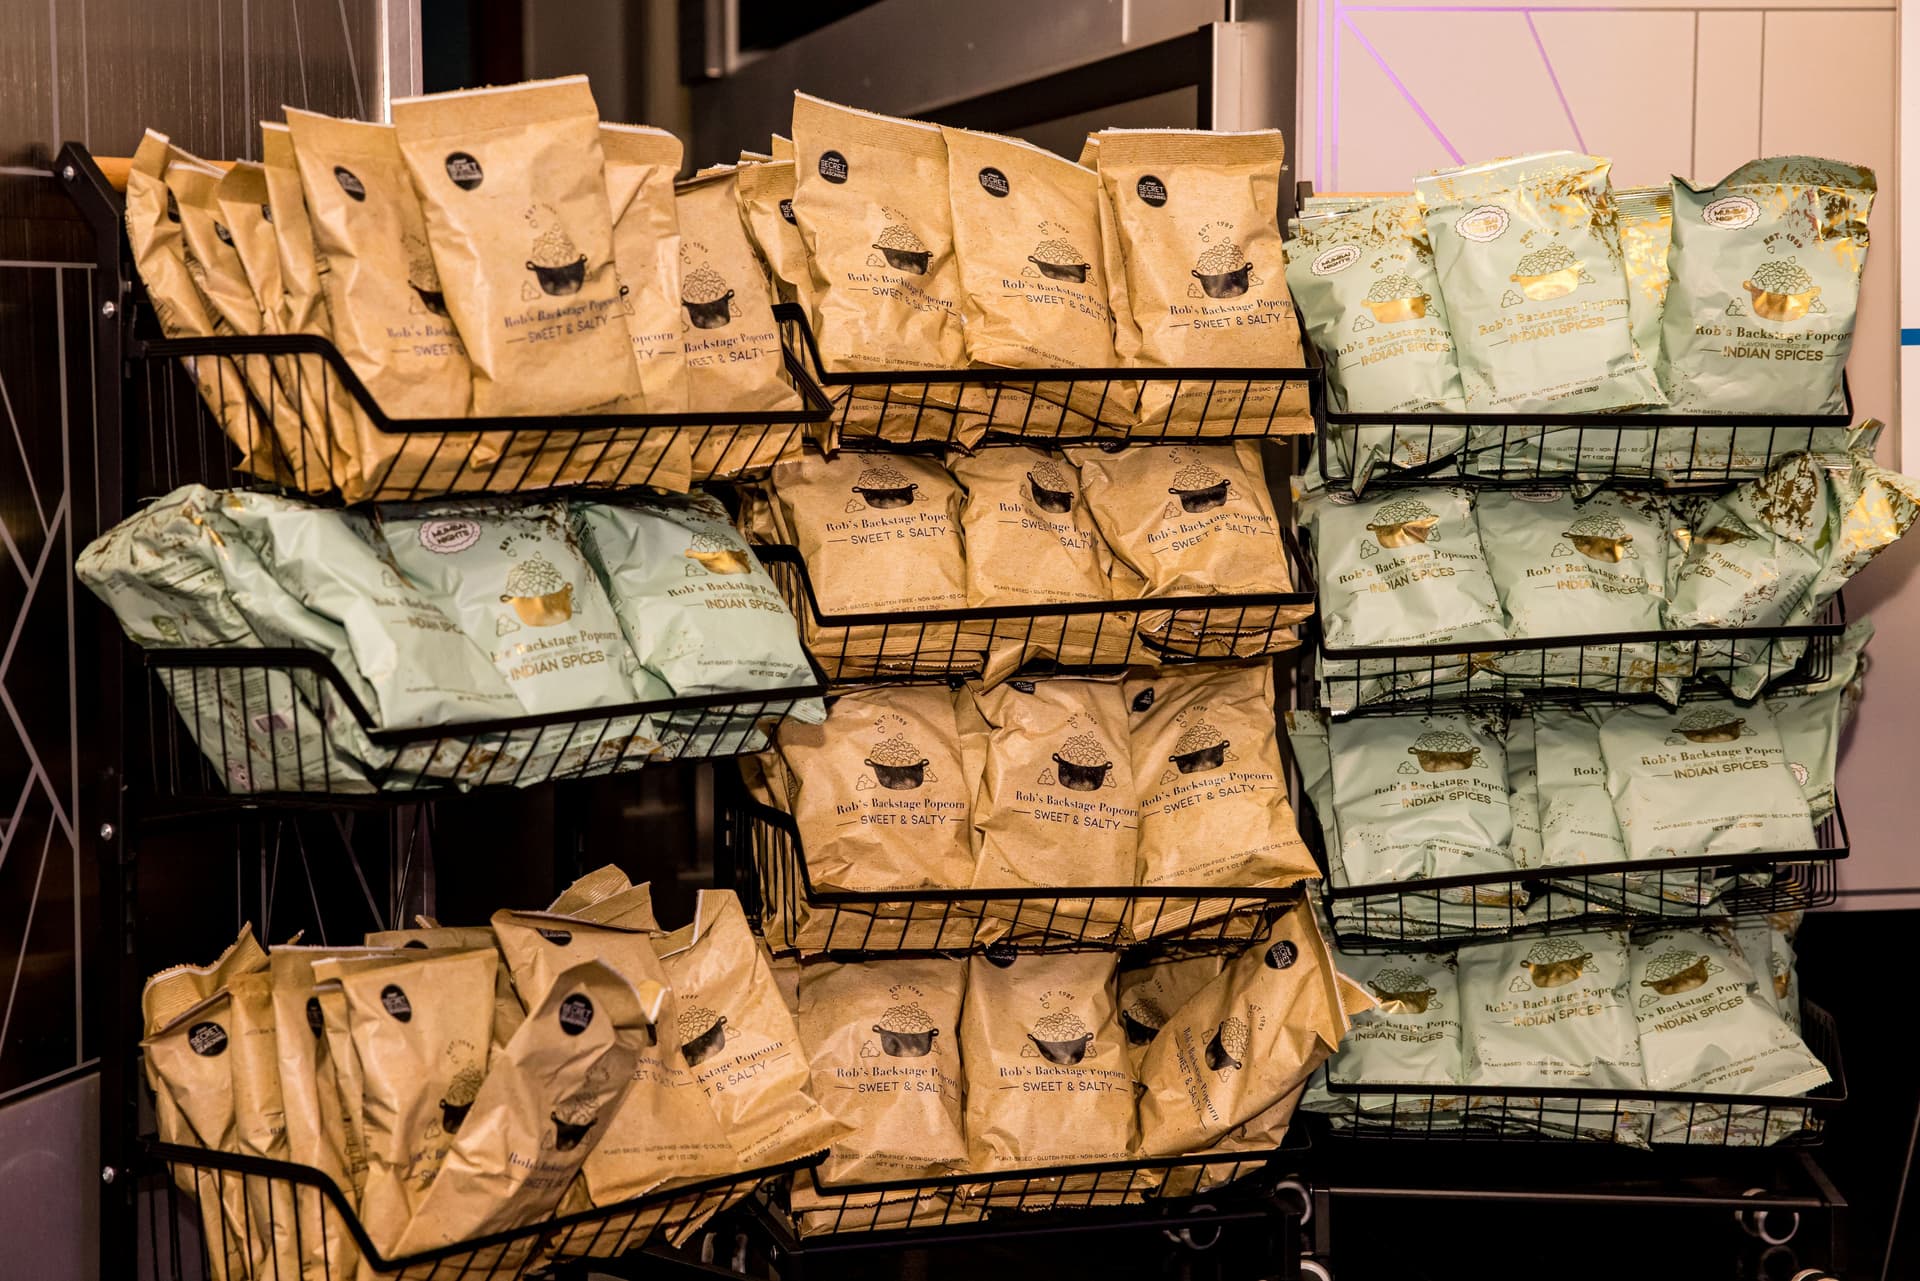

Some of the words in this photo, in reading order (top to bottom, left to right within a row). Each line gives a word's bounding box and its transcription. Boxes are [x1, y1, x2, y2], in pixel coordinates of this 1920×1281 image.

[847, 272, 879, 284] Rob's
[1002, 278, 1035, 291] Rob's
[1037, 282, 1088, 301] Backstage
[1025, 294, 1066, 306] SWEET
[1069, 299, 1077, 309] &
[1079, 303, 1108, 324] SALTY
[1169, 304, 1199, 317] Rob's
[1201, 302, 1255, 317] Backstage
[527, 325, 562, 343] SWEET
[577, 314, 608, 332] SALTY
[1193, 317, 1231, 330] SWEET
[1236, 316, 1244, 327] &
[1247, 313, 1281, 326] SALTY
[1478, 317, 1514, 337] Rob's
[1559, 317, 1606, 335] SPICES
[1695, 323, 1733, 337] Rob's
[683, 335, 738, 353] Backstage
[730, 347, 765, 363] SALTY
[1775, 348, 1824, 362] SPICES
[826, 519, 859, 532] Rob's
[861, 515, 917, 530] Backstage
[1146, 527, 1178, 544] Rob's
[1180, 512, 1231, 533] Backstage
[851, 531, 892, 545] SWEET
[897, 530, 905, 539] &
[909, 526, 947, 538] SALTY
[1171, 531, 1210, 551] SWEET
[1225, 522, 1257, 535] SALTY
[1338, 568, 1374, 585] Rob's
[1433, 549, 1479, 562] Popcorn
[1412, 566, 1456, 582] SPICES
[1526, 565, 1562, 578] Rob's
[1564, 563, 1619, 584] Backstage
[1710, 552, 1753, 580] Popcorn
[667, 582, 705, 598] Rob's
[1556, 579, 1600, 592] INDIAN
[704, 599, 747, 610] INDIAN
[510, 660, 559, 681] INDIAN
[561, 651, 605, 669] SPICES
[1641, 752, 1678, 766] Rob's
[1680, 747, 1742, 764] Backstage
[1744, 745, 1783, 757] Popco
[1673, 764, 1719, 779] INDIAN
[1722, 759, 1770, 774] SPICES
[1141, 791, 1171, 809] Rob's
[1172, 776, 1227, 797] Backstage
[1229, 771, 1274, 782] Popcorn
[1374, 781, 1407, 796] Rob's
[1410, 778, 1470, 792] Backstage
[836, 799, 869, 815] Rob's
[871, 797, 921, 811] Backstage
[923, 798, 966, 811] Popcorn
[1015, 790, 1044, 804] Rob's
[1046, 794, 1097, 812] Backstage
[1163, 795, 1202, 815] SWEET
[1206, 791, 1216, 802] &
[1218, 784, 1256, 798] SALTY
[1402, 793, 1445, 808] INDIAN
[1449, 791, 1493, 805] SPICES
[860, 814, 896, 825] SWEET
[900, 815, 908, 825] &
[911, 814, 947, 825] SALTY
[1034, 809, 1070, 824] SWEET
[1072, 815, 1080, 825] &
[1083, 816, 1121, 830] SALTY
[1559, 1003, 1602, 1020] SPICES
[1656, 988, 1716, 1017] Backstage
[1654, 1013, 1699, 1034] INDIAN
[1701, 995, 1744, 1019] SPICES
[1354, 1032, 1396, 1042] INDIAN
[1401, 1031, 1444, 1044] SPICES
[735, 1040, 783, 1065] Popcorn
[1176, 1050, 1191, 1075] SWEET
[716, 1081, 726, 1093] &
[727, 1060, 767, 1086] SALTY
[836, 1066, 869, 1079] Rob's
[872, 1066, 928, 1078] Backstage
[999, 1065, 1032, 1078] Rob's
[1035, 1065, 1088, 1079] Backstage
[1184, 1077, 1193, 1085] &
[858, 1081, 899, 1093] SWEET
[903, 1081, 912, 1091] &
[1023, 1082, 1062, 1092] SWEET
[1067, 1081, 1076, 1091] &
[1078, 1081, 1113, 1093] SALTY
[1187, 1087, 1201, 1114] SALTY
[1200, 1081, 1220, 1122] Popcorn
[1036, 1154, 1076, 1162] GLUTEN-FREE
